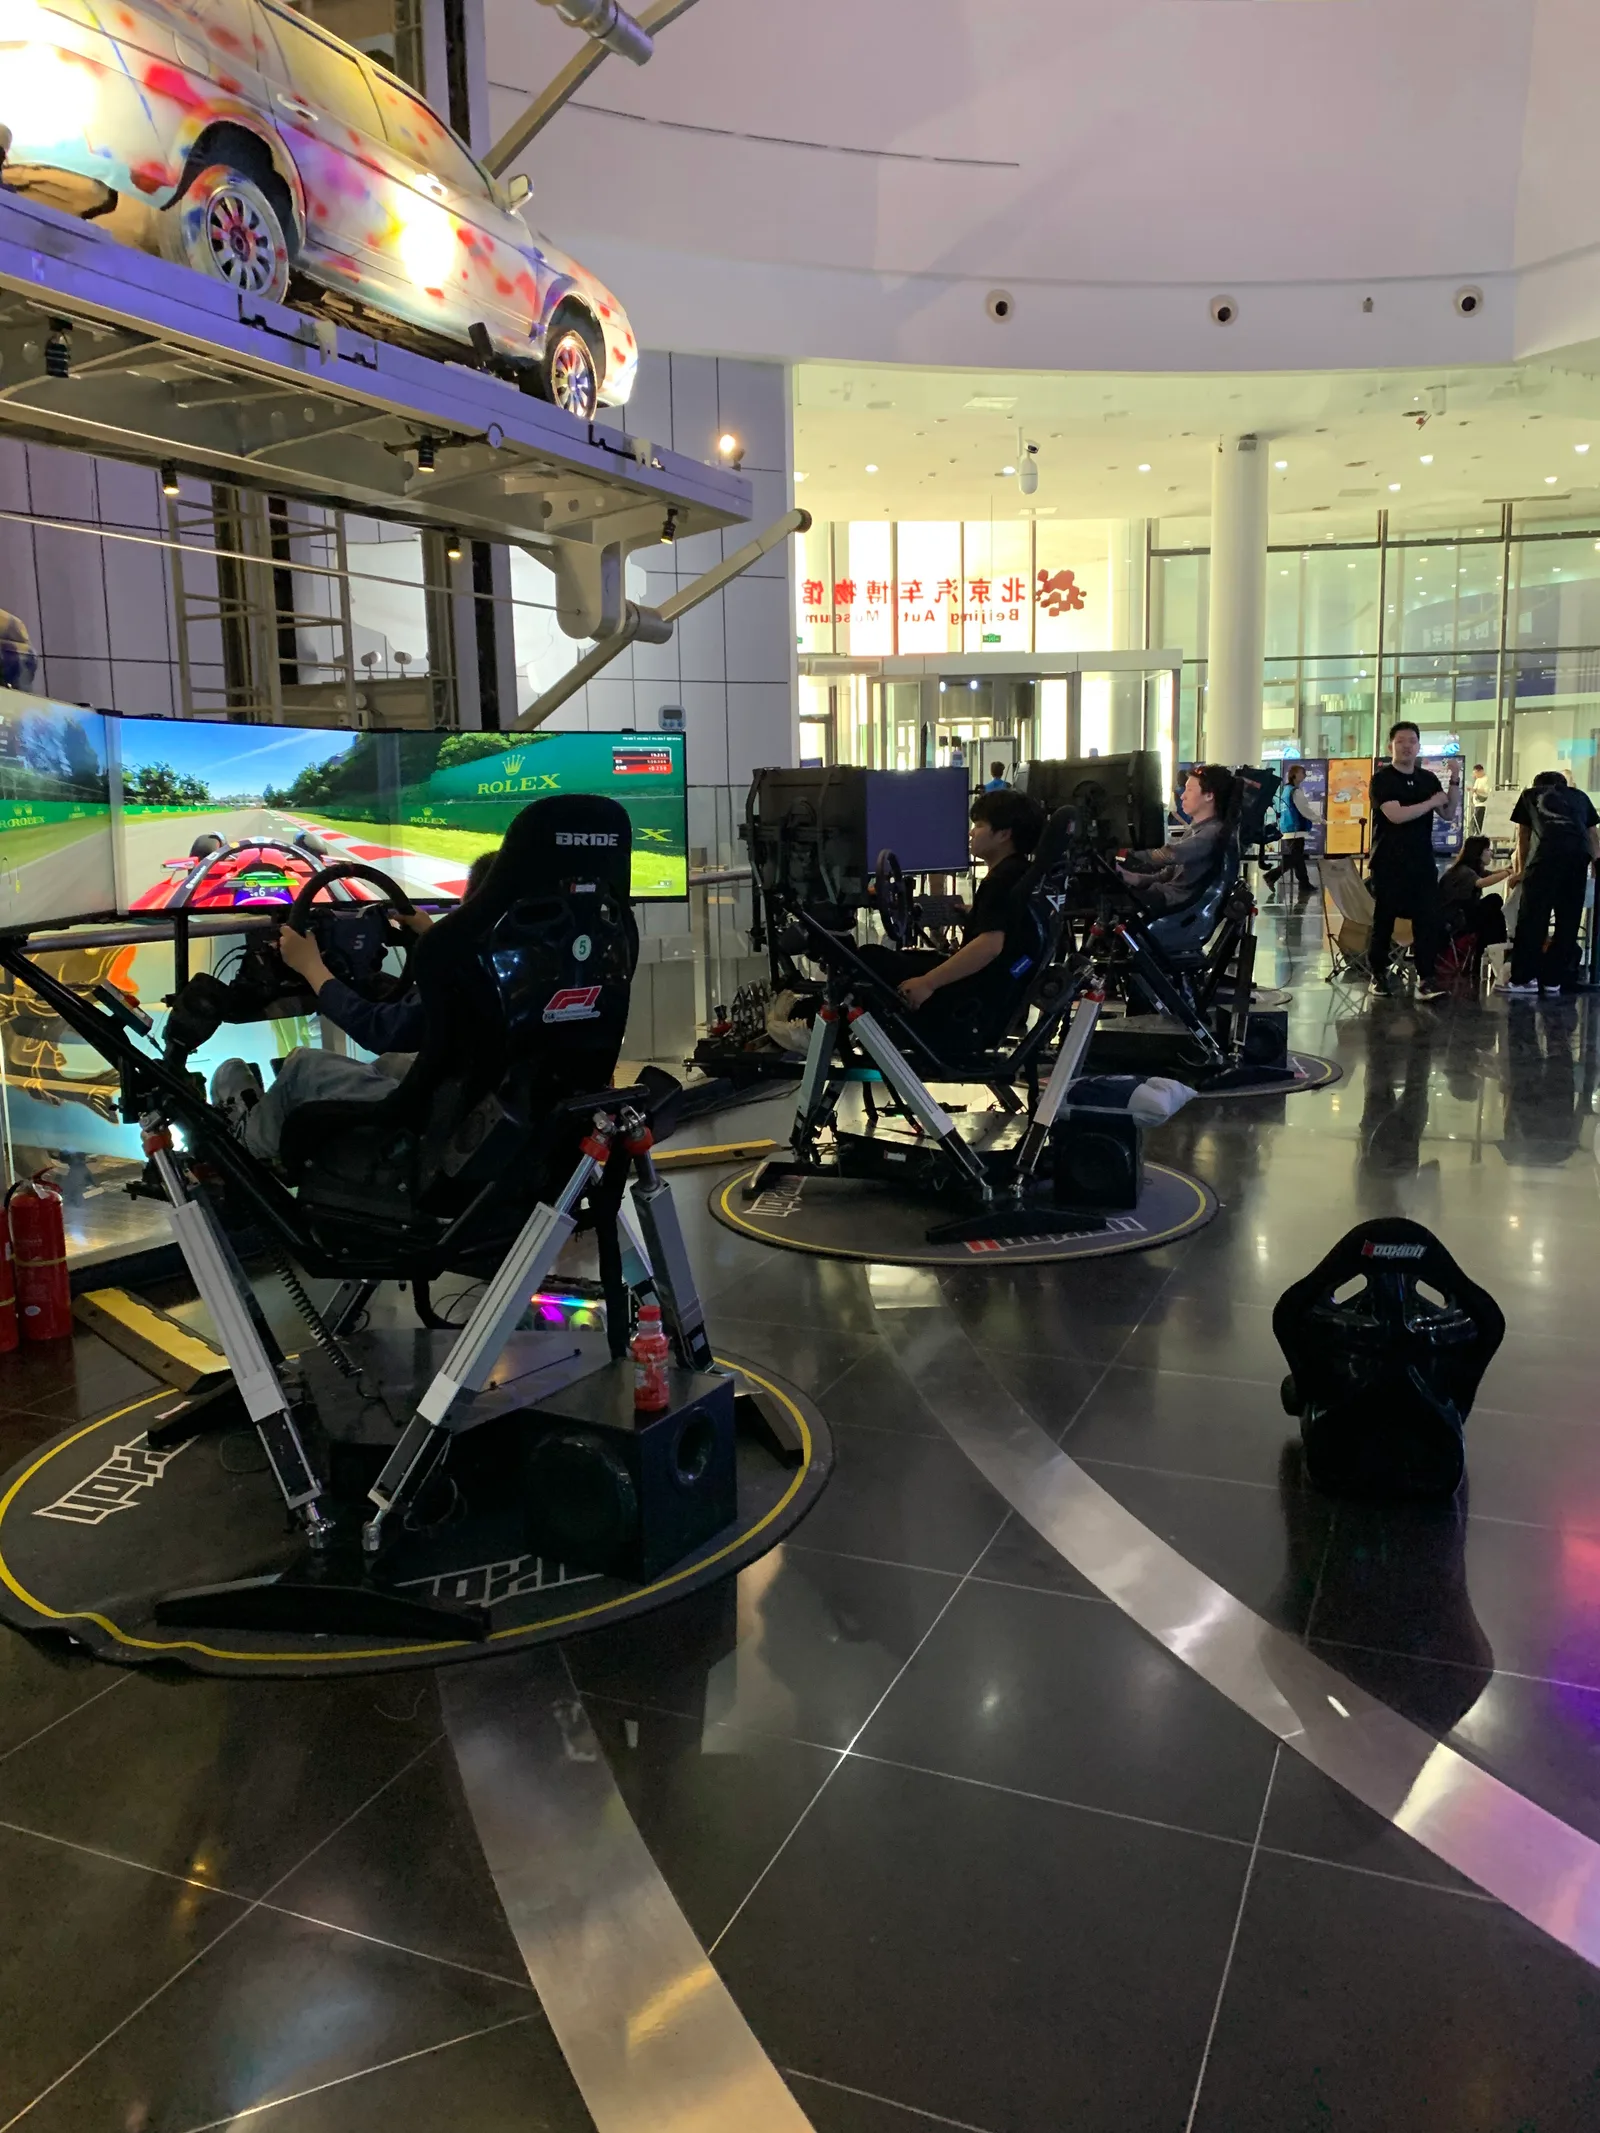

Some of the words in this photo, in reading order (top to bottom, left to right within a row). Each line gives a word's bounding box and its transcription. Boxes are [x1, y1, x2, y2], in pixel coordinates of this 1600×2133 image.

[477, 773, 561, 795] ROLEX
[410, 816, 447, 825] ROLEX
[555, 832, 619, 847] BRIDE
